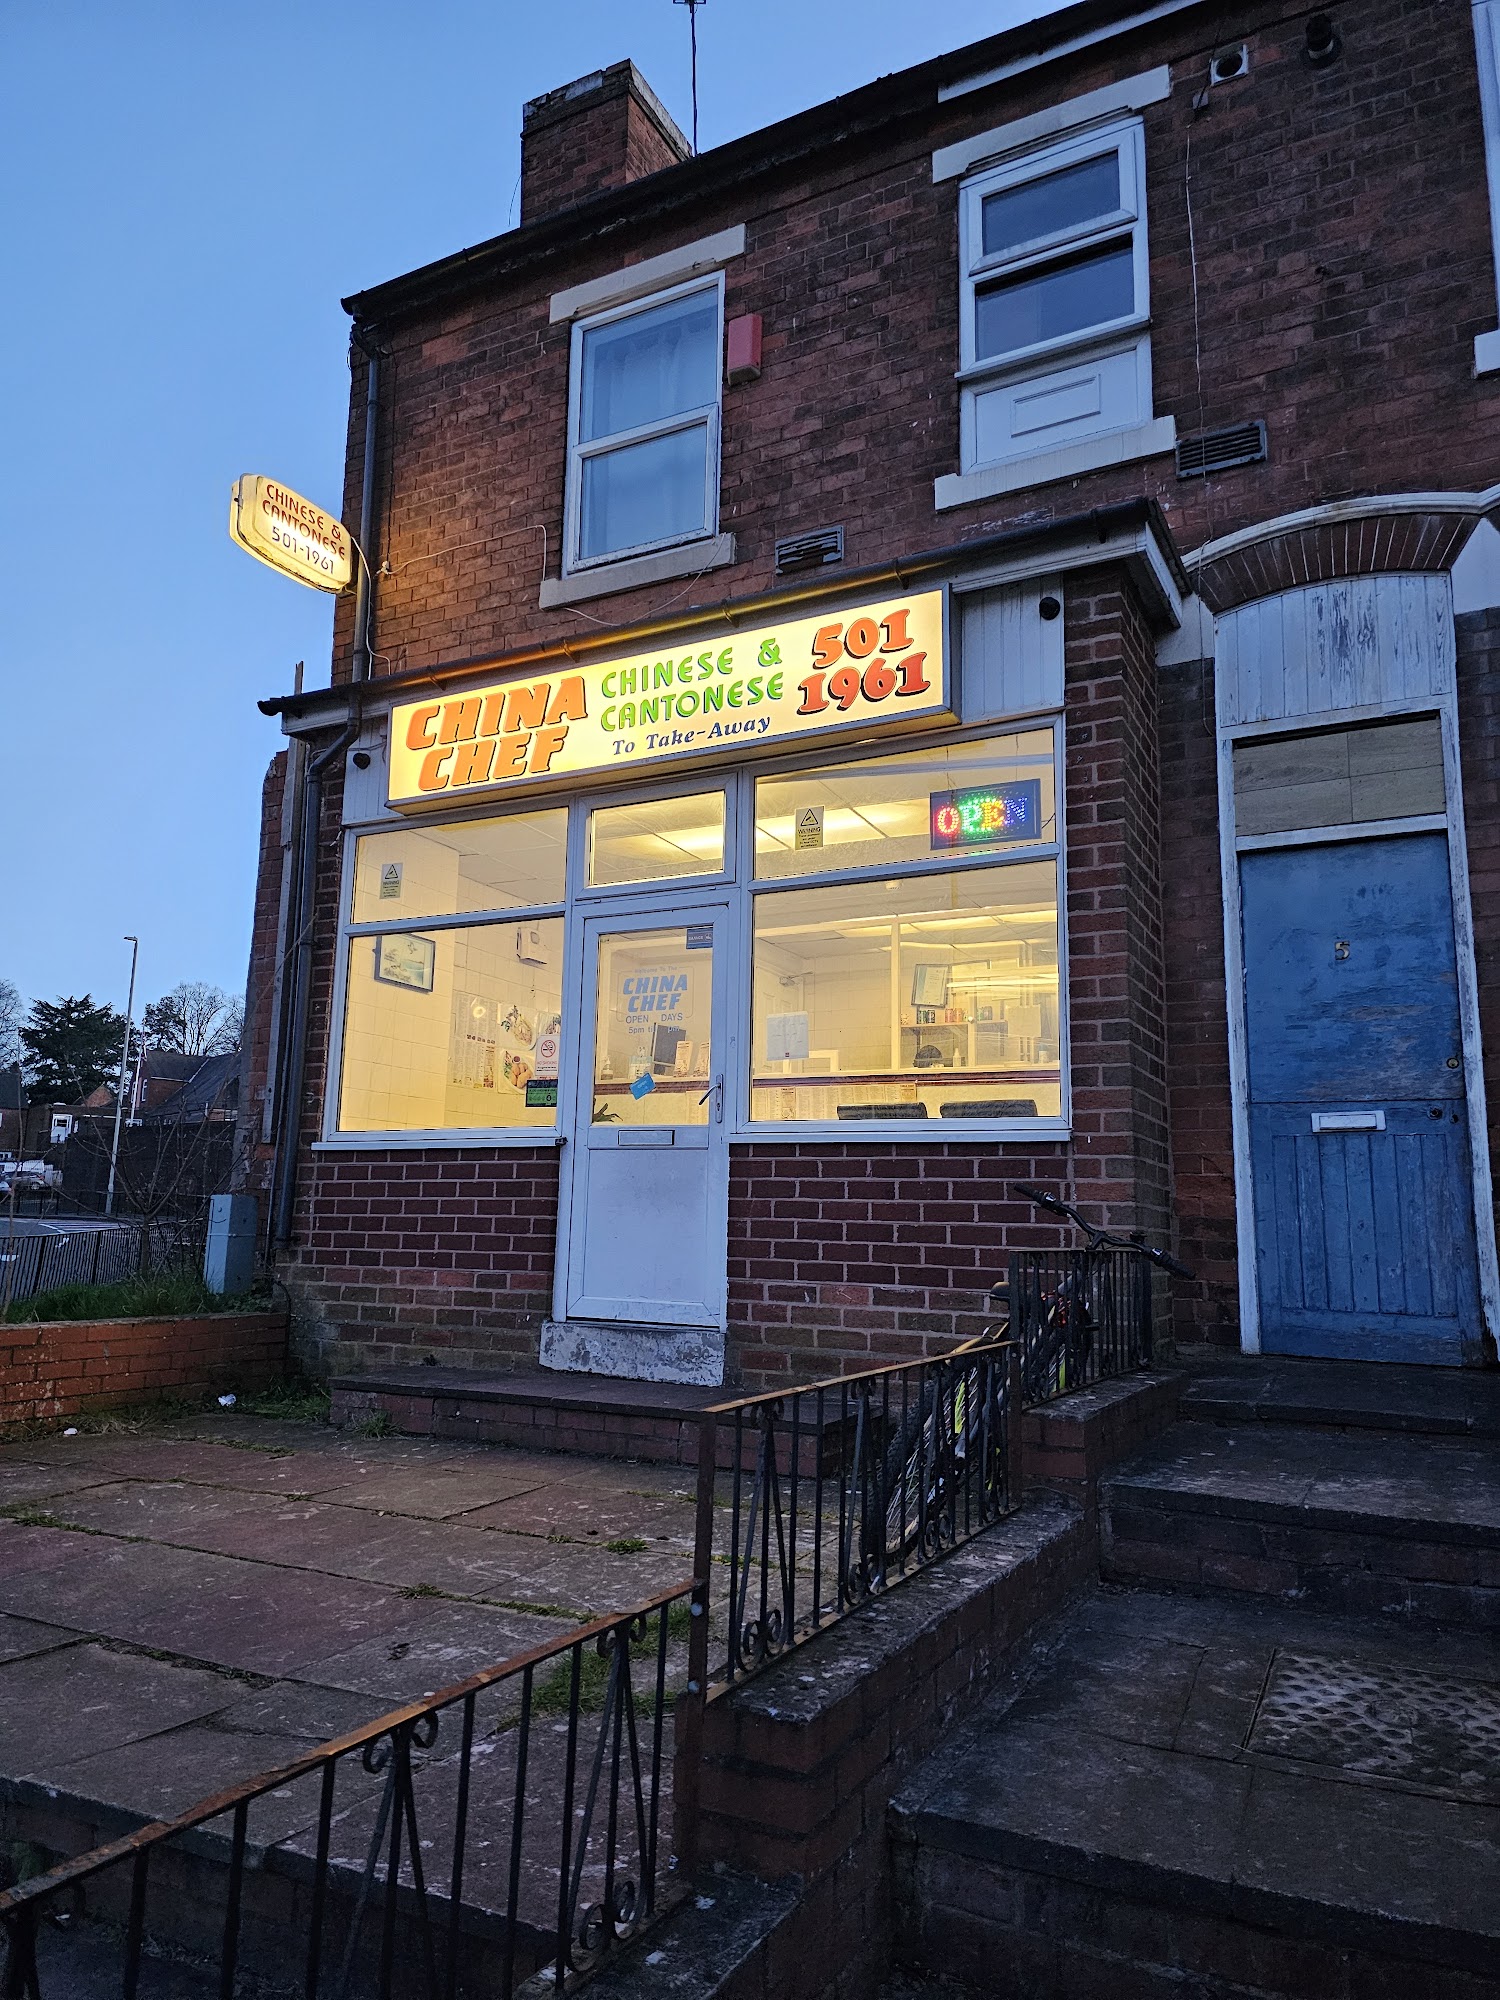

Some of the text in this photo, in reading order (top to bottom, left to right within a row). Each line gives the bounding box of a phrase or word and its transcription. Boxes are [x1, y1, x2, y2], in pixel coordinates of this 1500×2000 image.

[262, 499, 345, 561] CANTONESE
[266, 484, 342, 542] CHINESE &
[271, 525, 334, 575] 501-1961
[811, 608, 914, 670] 501
[601, 637, 783, 698] CHINESE &
[796, 651, 931, 716] 1961
[405, 675, 589, 751] CHINA
[600, 671, 784, 732] CANTONESE
[417, 725, 569, 792] CHEF
[612, 716, 771, 756] To Take-Away
[937, 797, 1028, 834] OPEN
[1335, 941, 1350, 960] 5
[622, 973, 688, 995] CHINA
[627, 992, 682, 1013] CHEF
[625, 1012, 683, 1024] OPEN DAYS
[628, 1026, 645, 1034] 5pm
